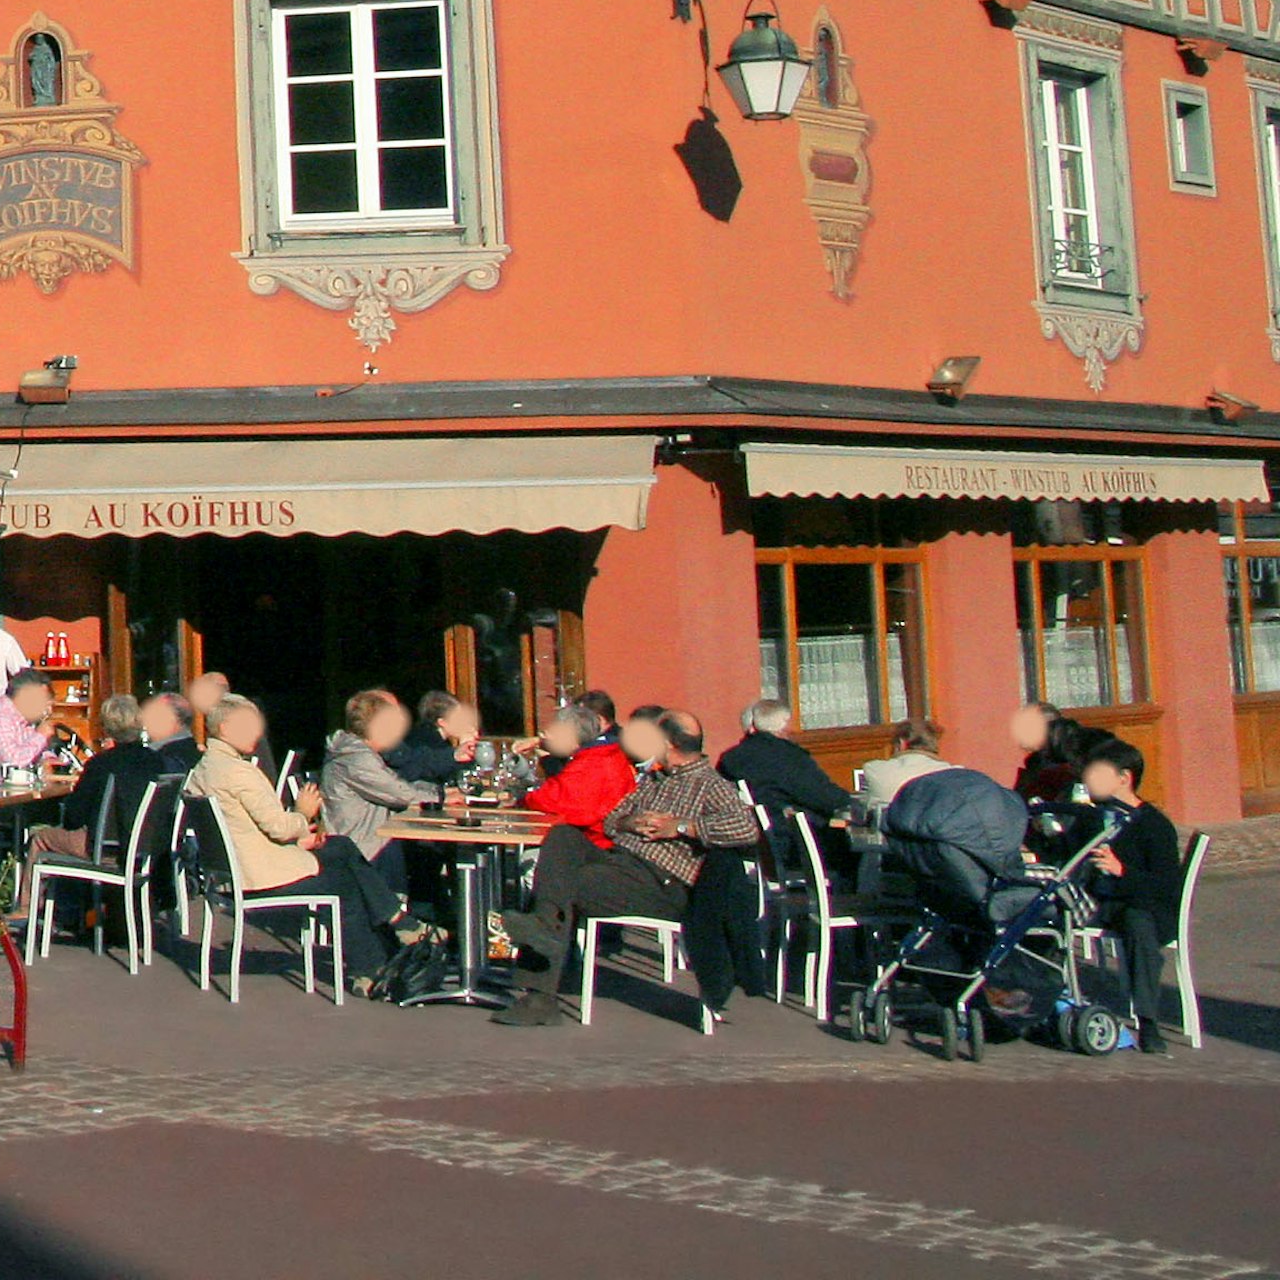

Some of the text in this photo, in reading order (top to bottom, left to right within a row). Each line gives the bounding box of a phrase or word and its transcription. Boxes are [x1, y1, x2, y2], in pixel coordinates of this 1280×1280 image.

[904, 465, 997, 491] RESTAURANT
[1009, 468, 1071, 493] WINSTUB
[1082, 470, 1098, 493] AU
[84, 504, 128, 529] AU
[142, 495, 296, 528] KOÏFHUS
